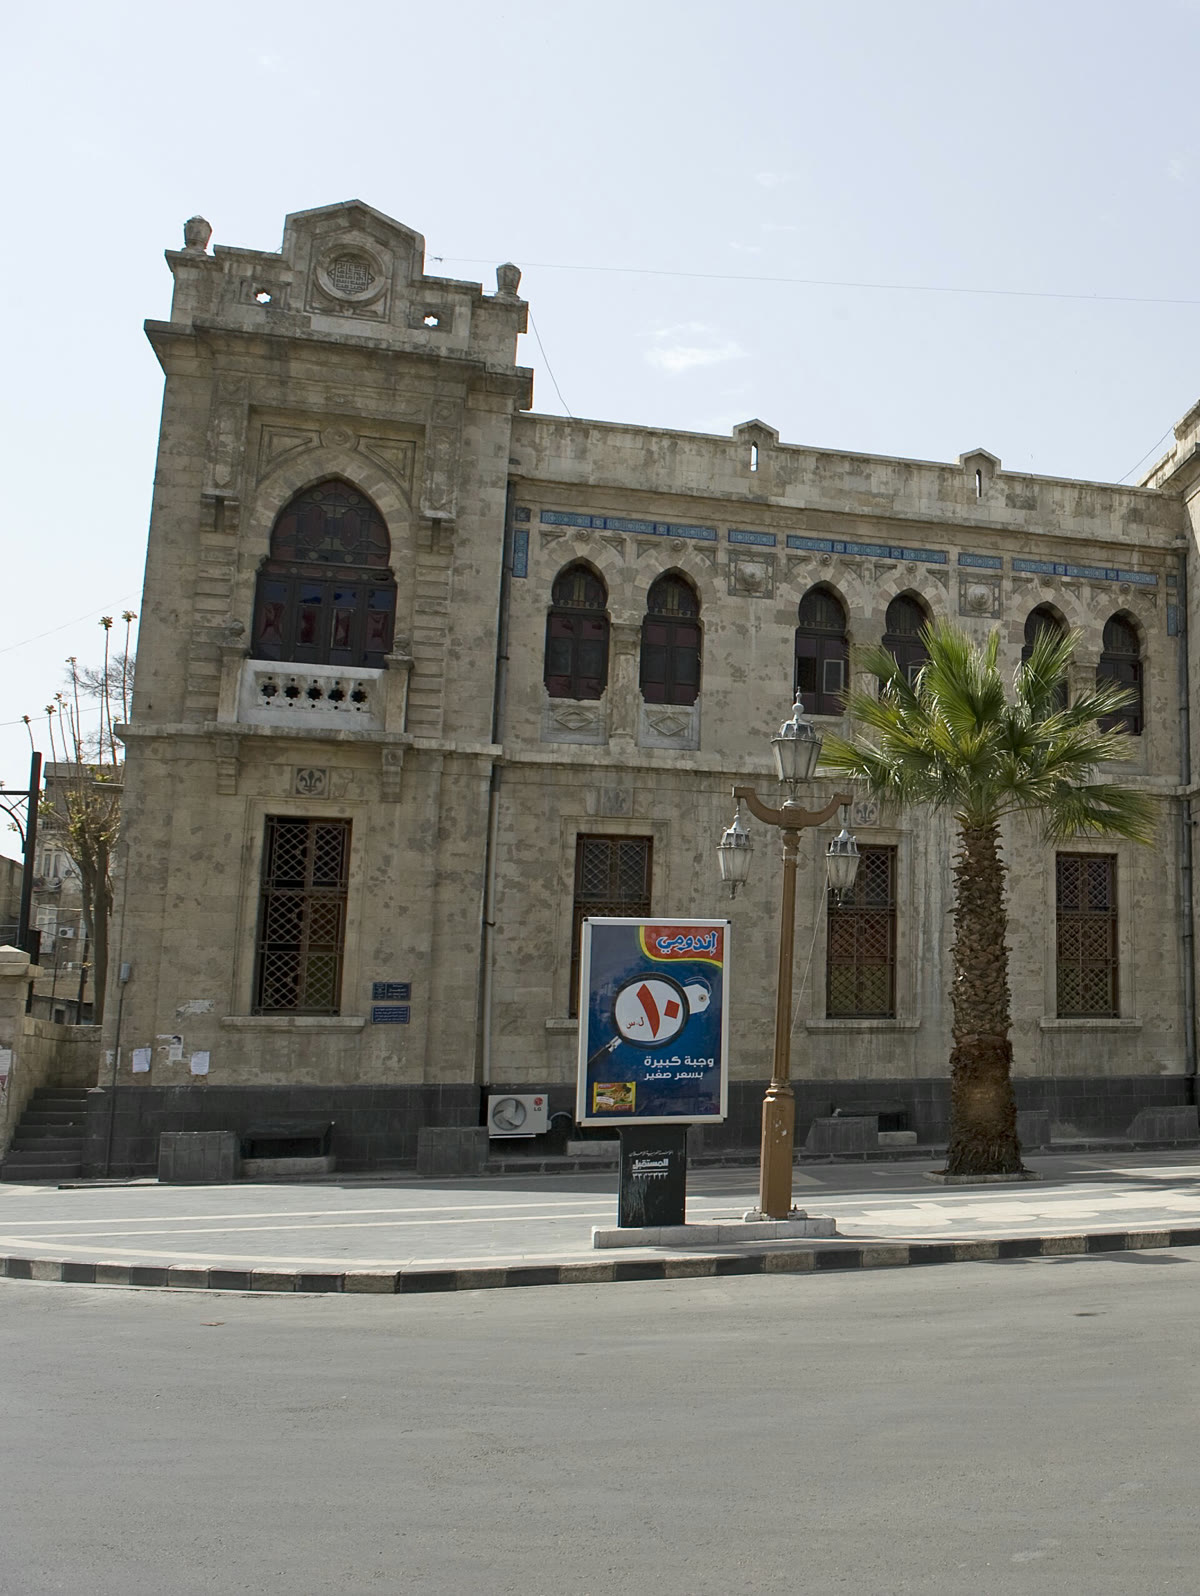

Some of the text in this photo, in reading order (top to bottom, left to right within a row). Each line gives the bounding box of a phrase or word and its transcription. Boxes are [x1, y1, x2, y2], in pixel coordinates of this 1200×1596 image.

[656, 931, 718, 956] إندومي
[636, 983, 680, 1039] ١٠
[644, 1055, 715, 1068] وجبة كبيرة
[644, 1070, 704, 1081] بسعر صغير
[632, 1158, 669, 1170] المستقبل
